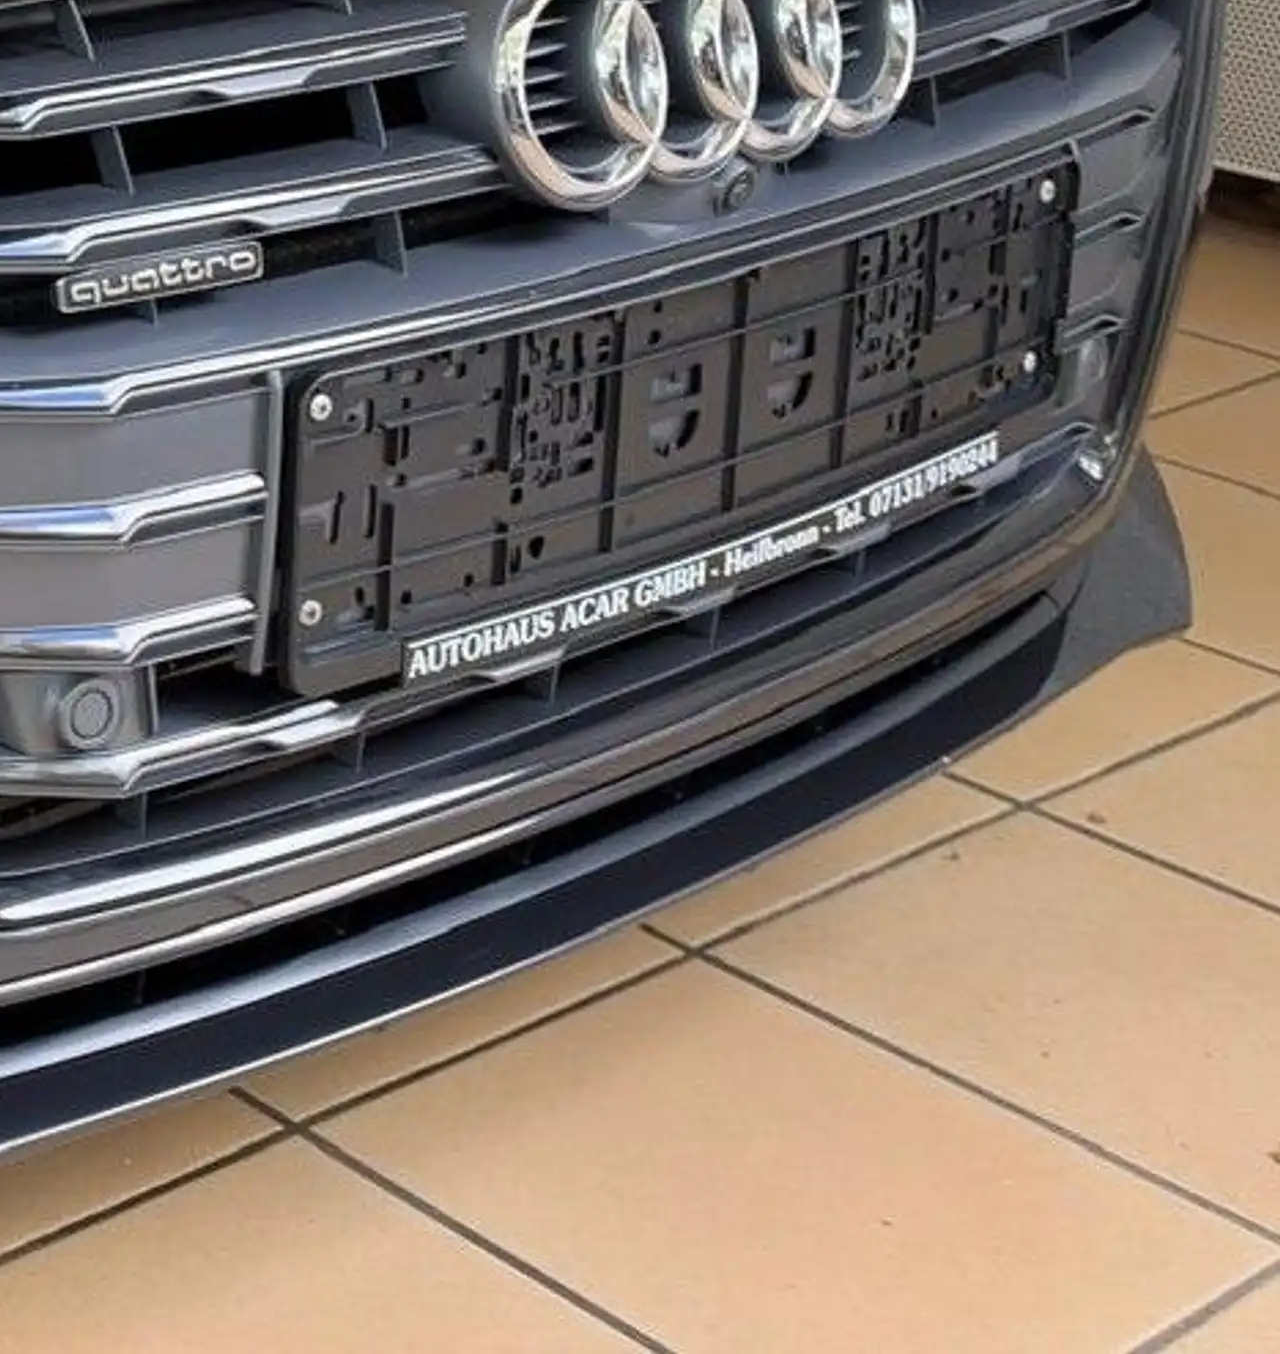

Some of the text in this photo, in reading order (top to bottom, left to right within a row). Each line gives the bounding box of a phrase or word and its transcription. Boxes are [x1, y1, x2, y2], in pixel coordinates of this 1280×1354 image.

[70, 250, 257, 303] quattro
[408, 610, 555, 679] AUTOHAUS
[559, 587, 629, 632] ACAR
[634, 559, 707, 607] GMBH
[723, 525, 820, 577] Heilbronn
[833, 500, 867, 532] Tel.
